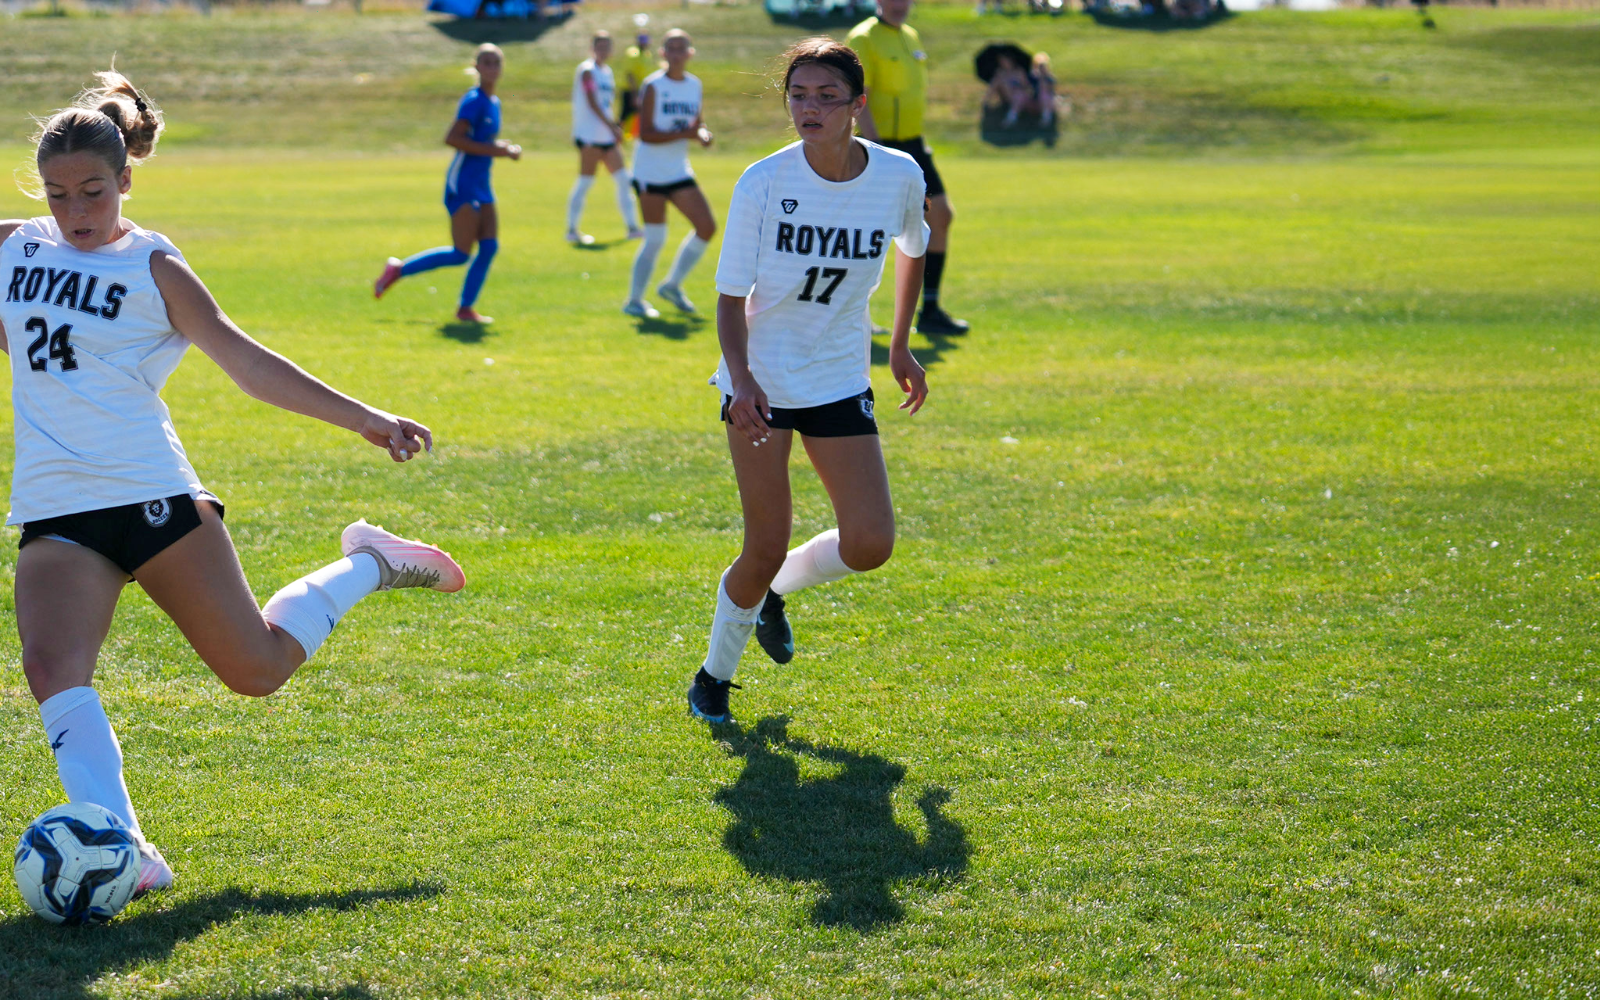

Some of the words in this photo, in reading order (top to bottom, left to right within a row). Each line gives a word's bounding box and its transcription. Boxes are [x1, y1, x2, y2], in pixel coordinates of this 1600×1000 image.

[776, 221, 885, 260] ROYALS
[5, 266, 129, 321] ROYALS
[797, 266, 849, 305] 17
[24, 316, 79, 372] 24
